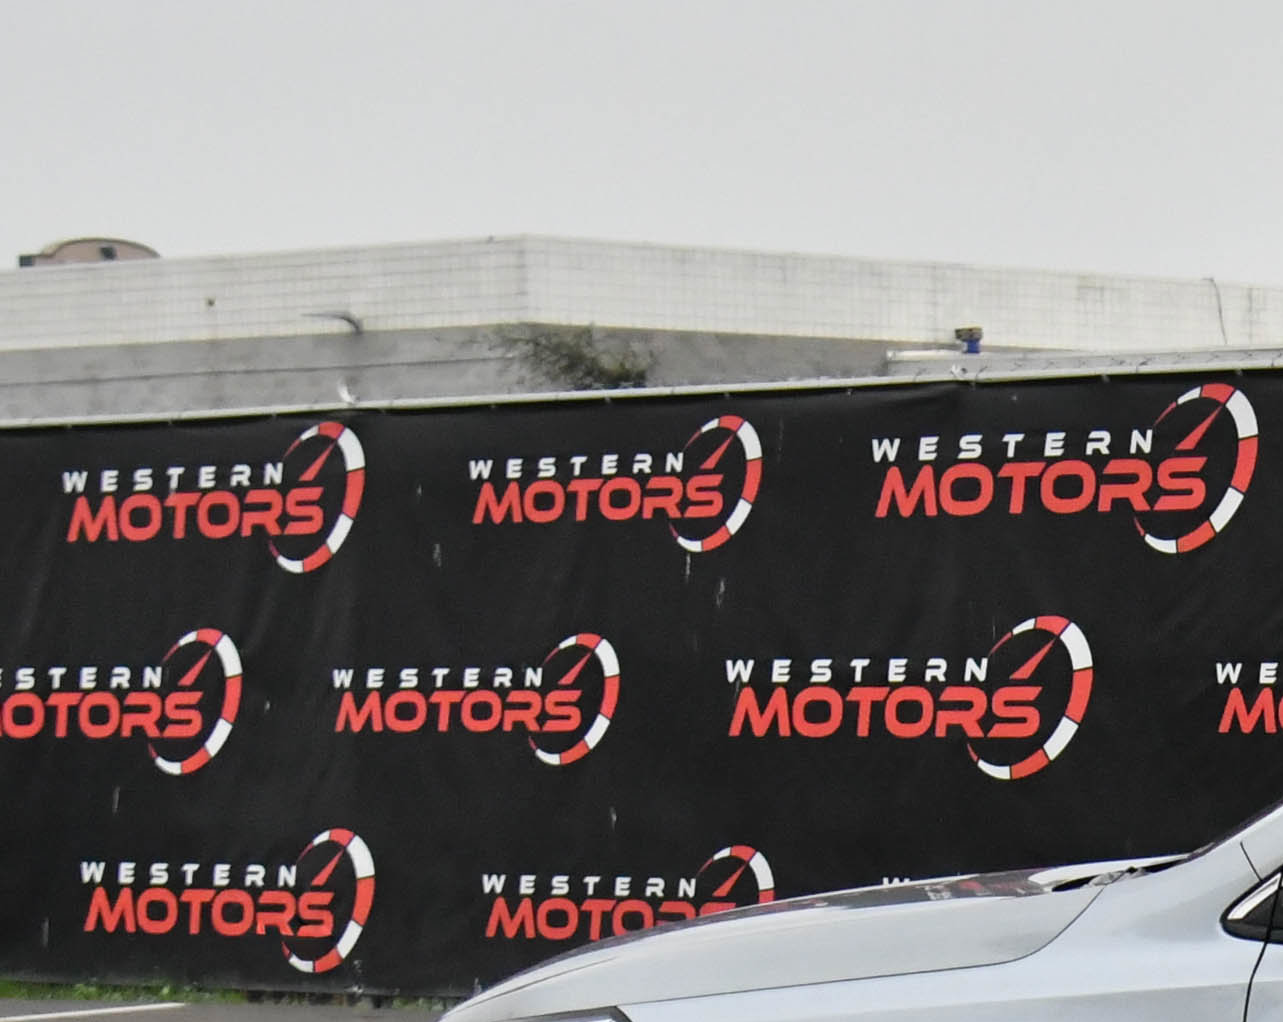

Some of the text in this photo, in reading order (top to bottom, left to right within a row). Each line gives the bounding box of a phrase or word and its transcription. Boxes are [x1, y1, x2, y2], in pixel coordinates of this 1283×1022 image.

[871, 429, 1153, 463] WESTERN
[62, 462, 284, 493] WESTERN
[469, 452, 684, 480] WESTERN
[472, 473, 724, 525] MOTORS
[874, 455, 1209, 519] MOTORS
[66, 485, 325, 544] MOTORS
[0, 666, 163, 690] STERN
[332, 667, 543, 689] WESTERN
[725, 657, 989, 683] WESTERN
[0, 690, 204, 740] OTORS
[335, 689, 583, 734] MOTORS
[727, 684, 1043, 740] MOTORS
[81, 861, 297, 887] WESTERN
[482, 874, 697, 898] WESTERN
[84, 886, 335, 938] MOTORS
